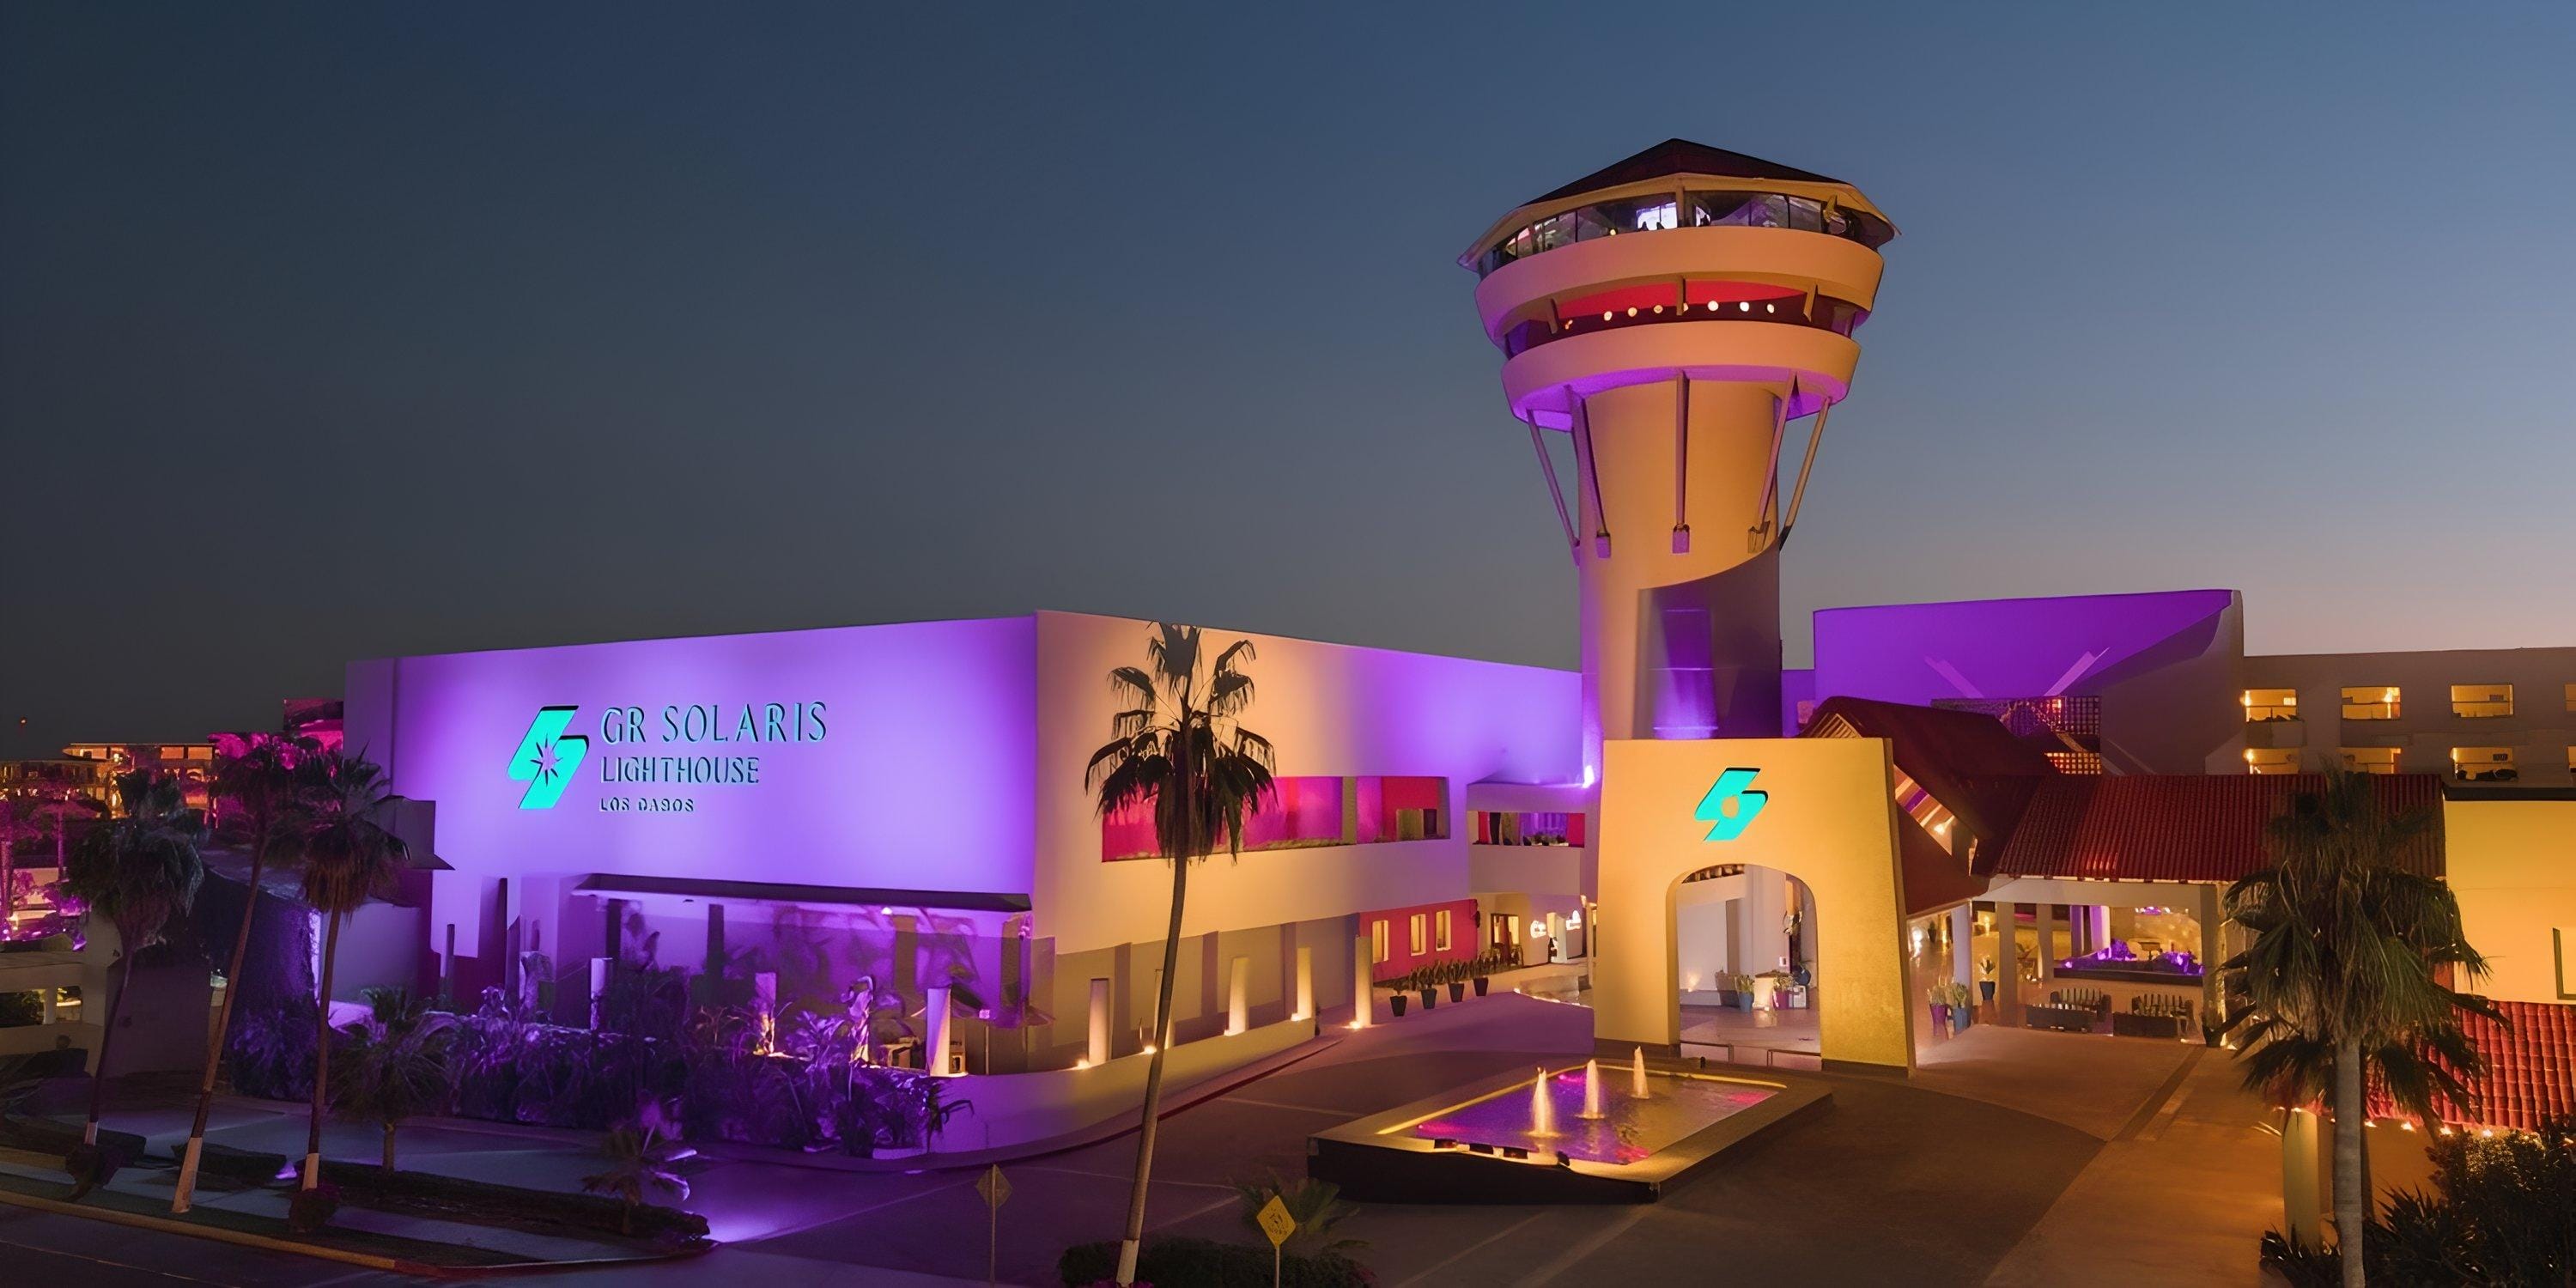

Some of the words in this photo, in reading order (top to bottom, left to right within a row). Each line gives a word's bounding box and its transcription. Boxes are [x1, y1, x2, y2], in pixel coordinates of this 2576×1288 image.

[601, 707, 646, 744] GR
[662, 701, 827, 743] SOLARIS
[601, 756, 760, 783] LIGHTHOUSE
[599, 797, 629, 811] LOS
